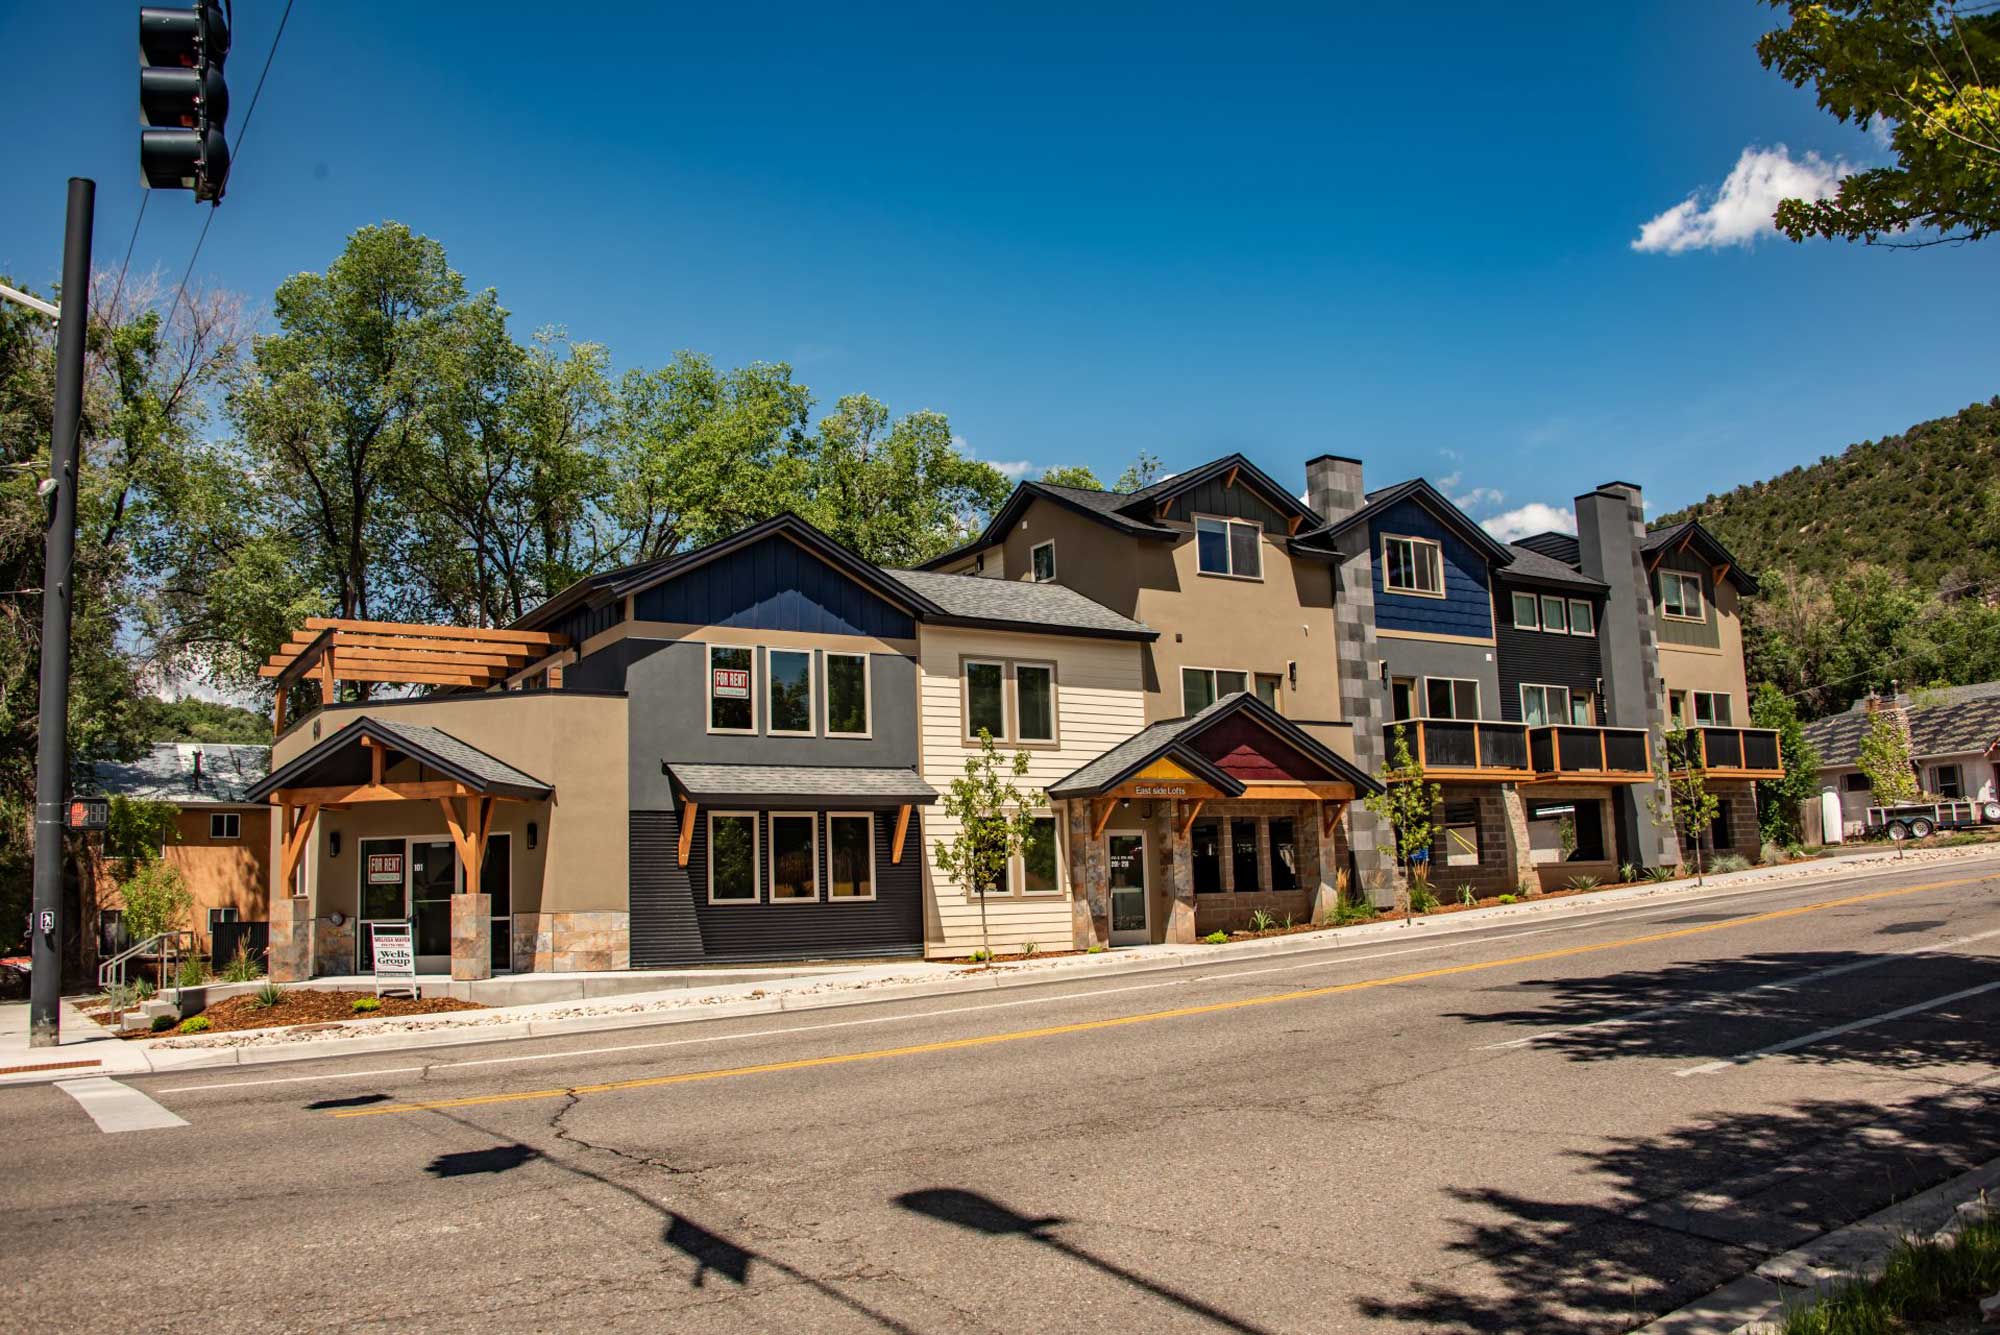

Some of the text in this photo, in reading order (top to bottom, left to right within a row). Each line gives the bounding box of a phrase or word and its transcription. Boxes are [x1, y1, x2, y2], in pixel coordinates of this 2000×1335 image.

[716, 672, 746, 686] FOR RENT
[1136, 786, 1185, 795] East side Lofts
[371, 857, 400, 872] FOR RENT
[414, 863, 424, 872] 101
[380, 950, 410, 958] Wells
[377, 957, 410, 966] Group
